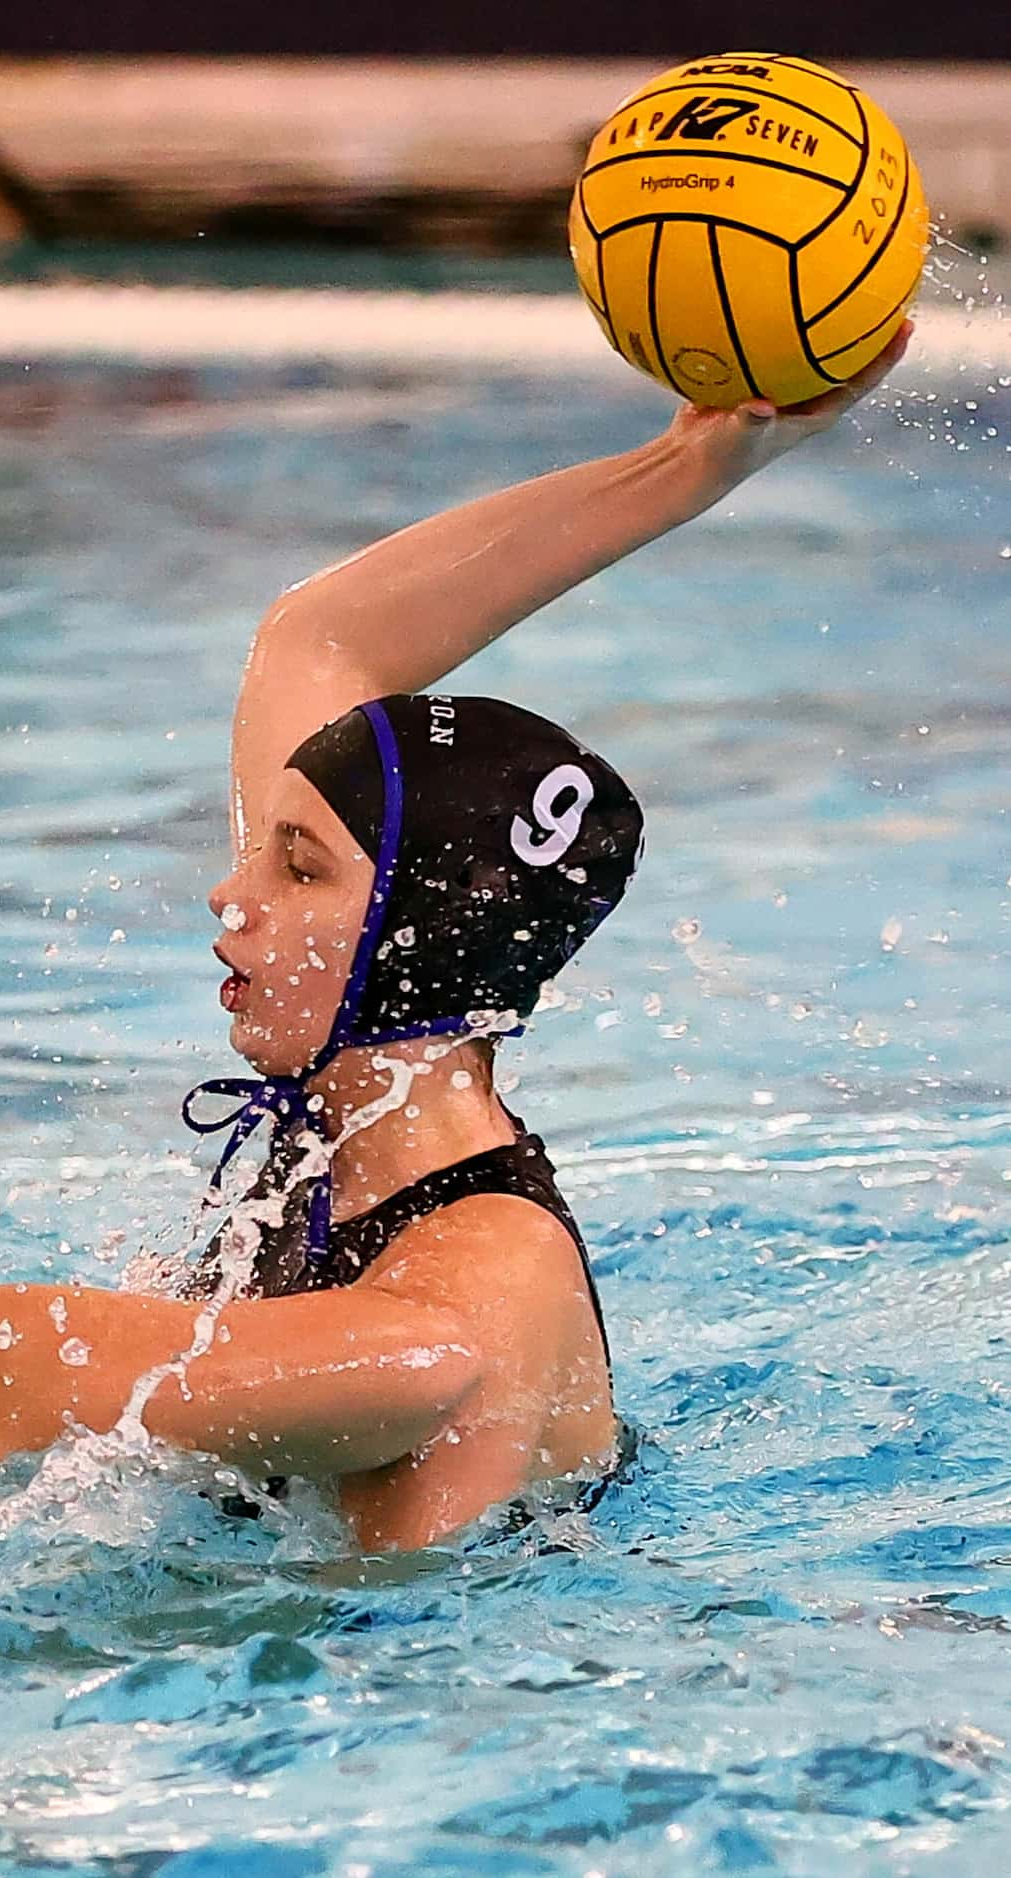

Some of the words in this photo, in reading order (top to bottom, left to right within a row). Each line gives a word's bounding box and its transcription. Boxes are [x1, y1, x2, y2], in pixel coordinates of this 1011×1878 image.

[746, 115, 819, 157] SEVEN
[640, 173, 720, 193] HydroGrip
[725, 175, 735, 189] 4
[853, 147, 899, 246] 2023
[510, 763, 594, 867] 9
